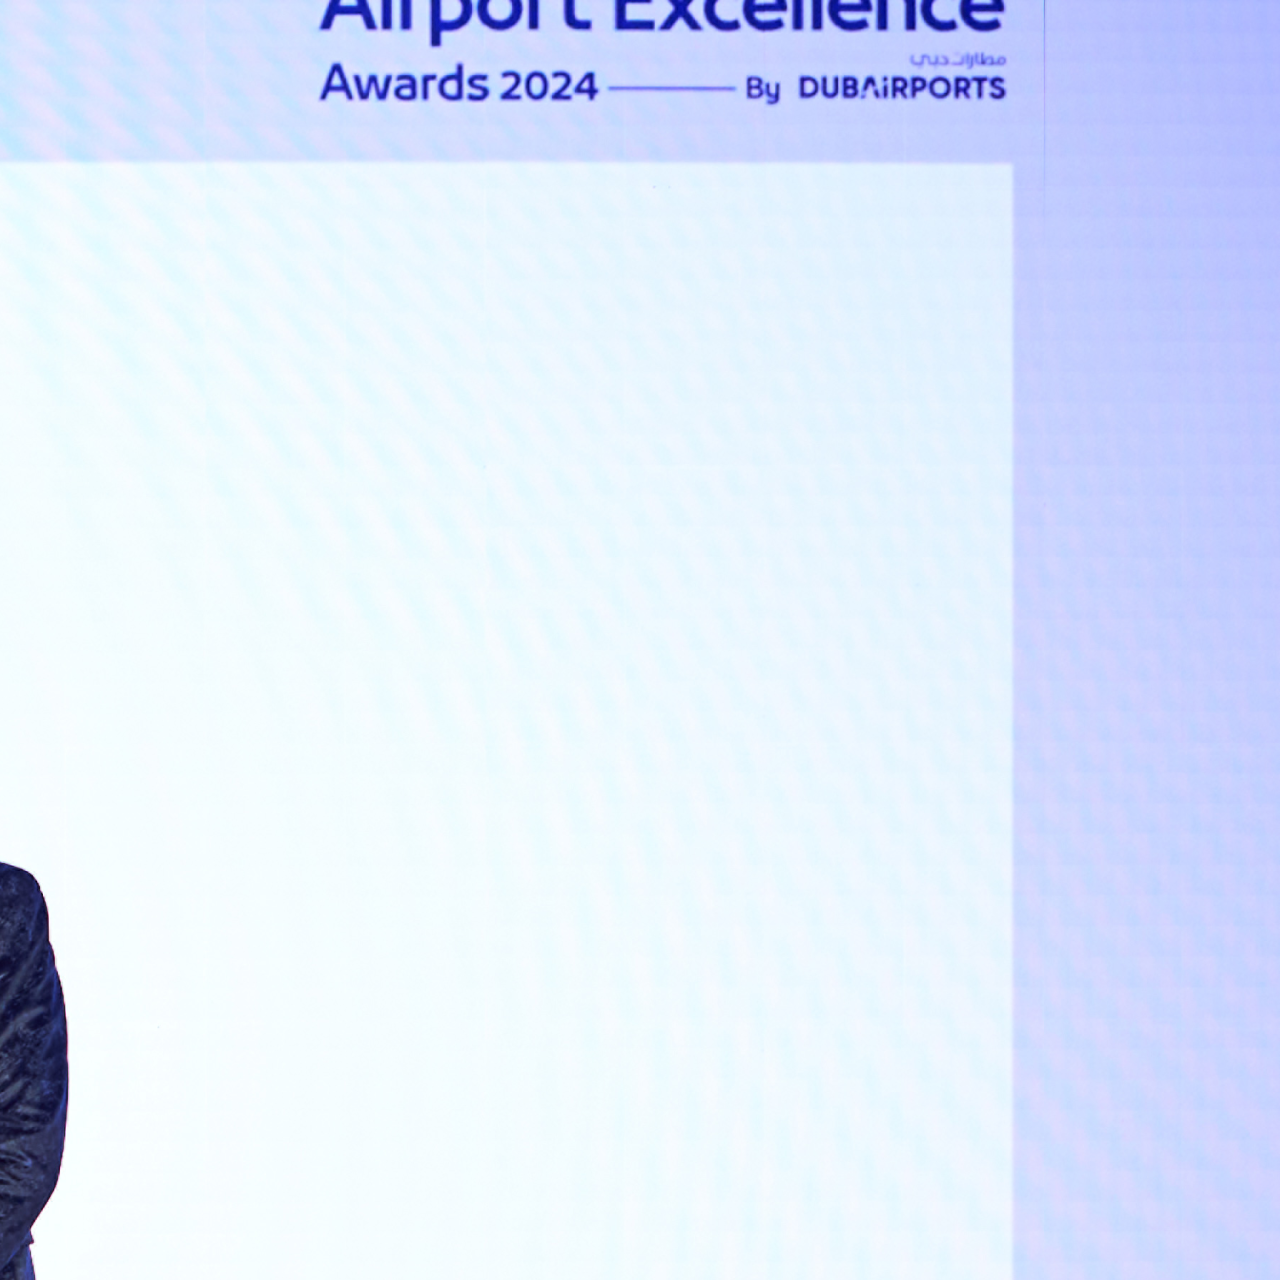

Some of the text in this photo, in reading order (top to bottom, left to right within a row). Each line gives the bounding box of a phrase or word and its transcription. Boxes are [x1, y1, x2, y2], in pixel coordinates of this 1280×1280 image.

[320, 62, 490, 101] Awards
[500, 71, 599, 101] 2024
[746, 75, 780, 104] By
